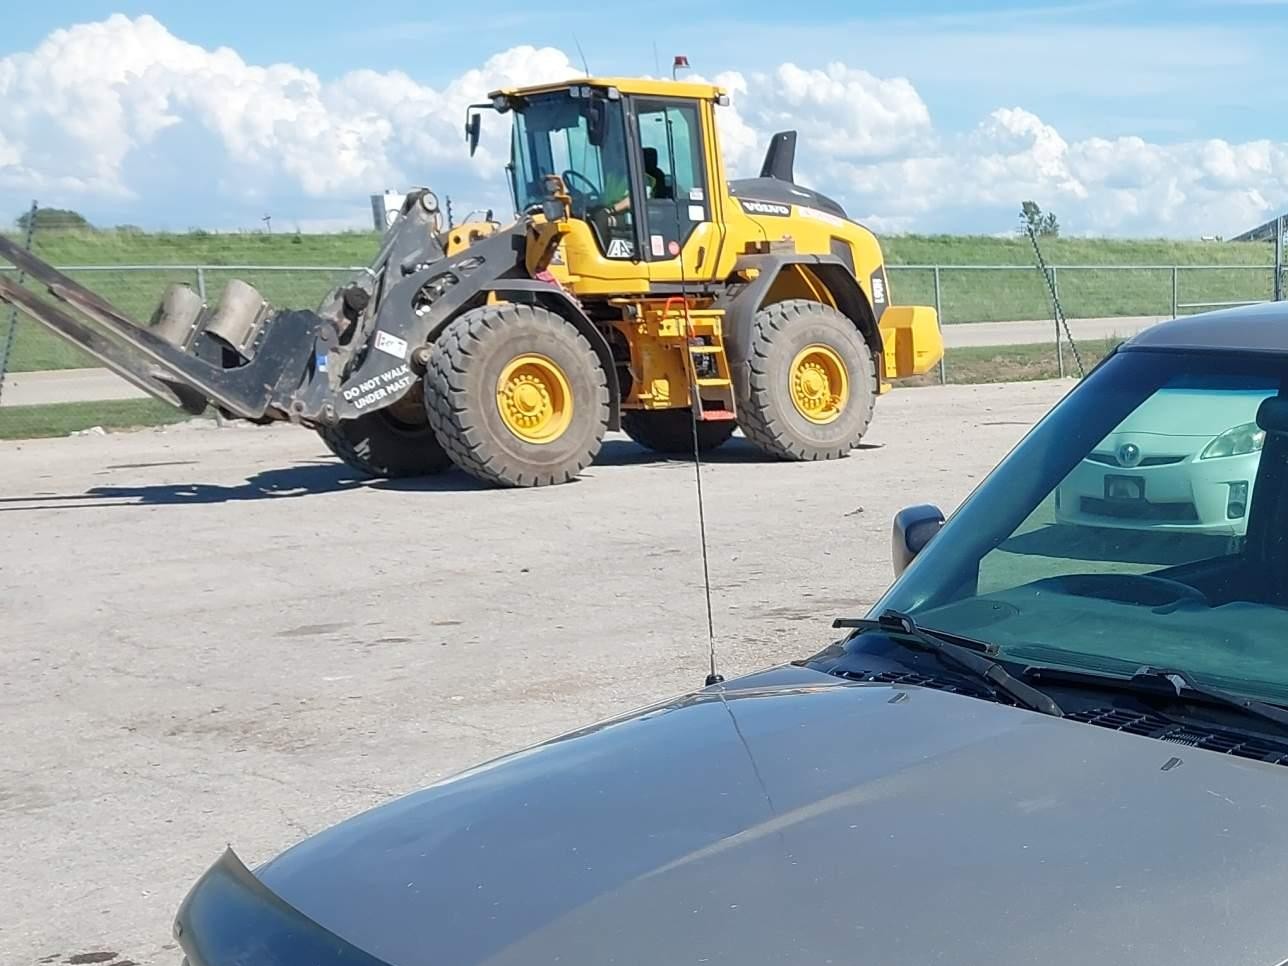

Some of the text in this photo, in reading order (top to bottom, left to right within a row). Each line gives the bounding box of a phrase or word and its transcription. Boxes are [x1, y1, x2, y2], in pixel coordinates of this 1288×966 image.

[742, 201, 790, 215] VOLVO
[343, 364, 409, 400] DO NOT WALK
[354, 376, 410, 409] UNDER MAST
